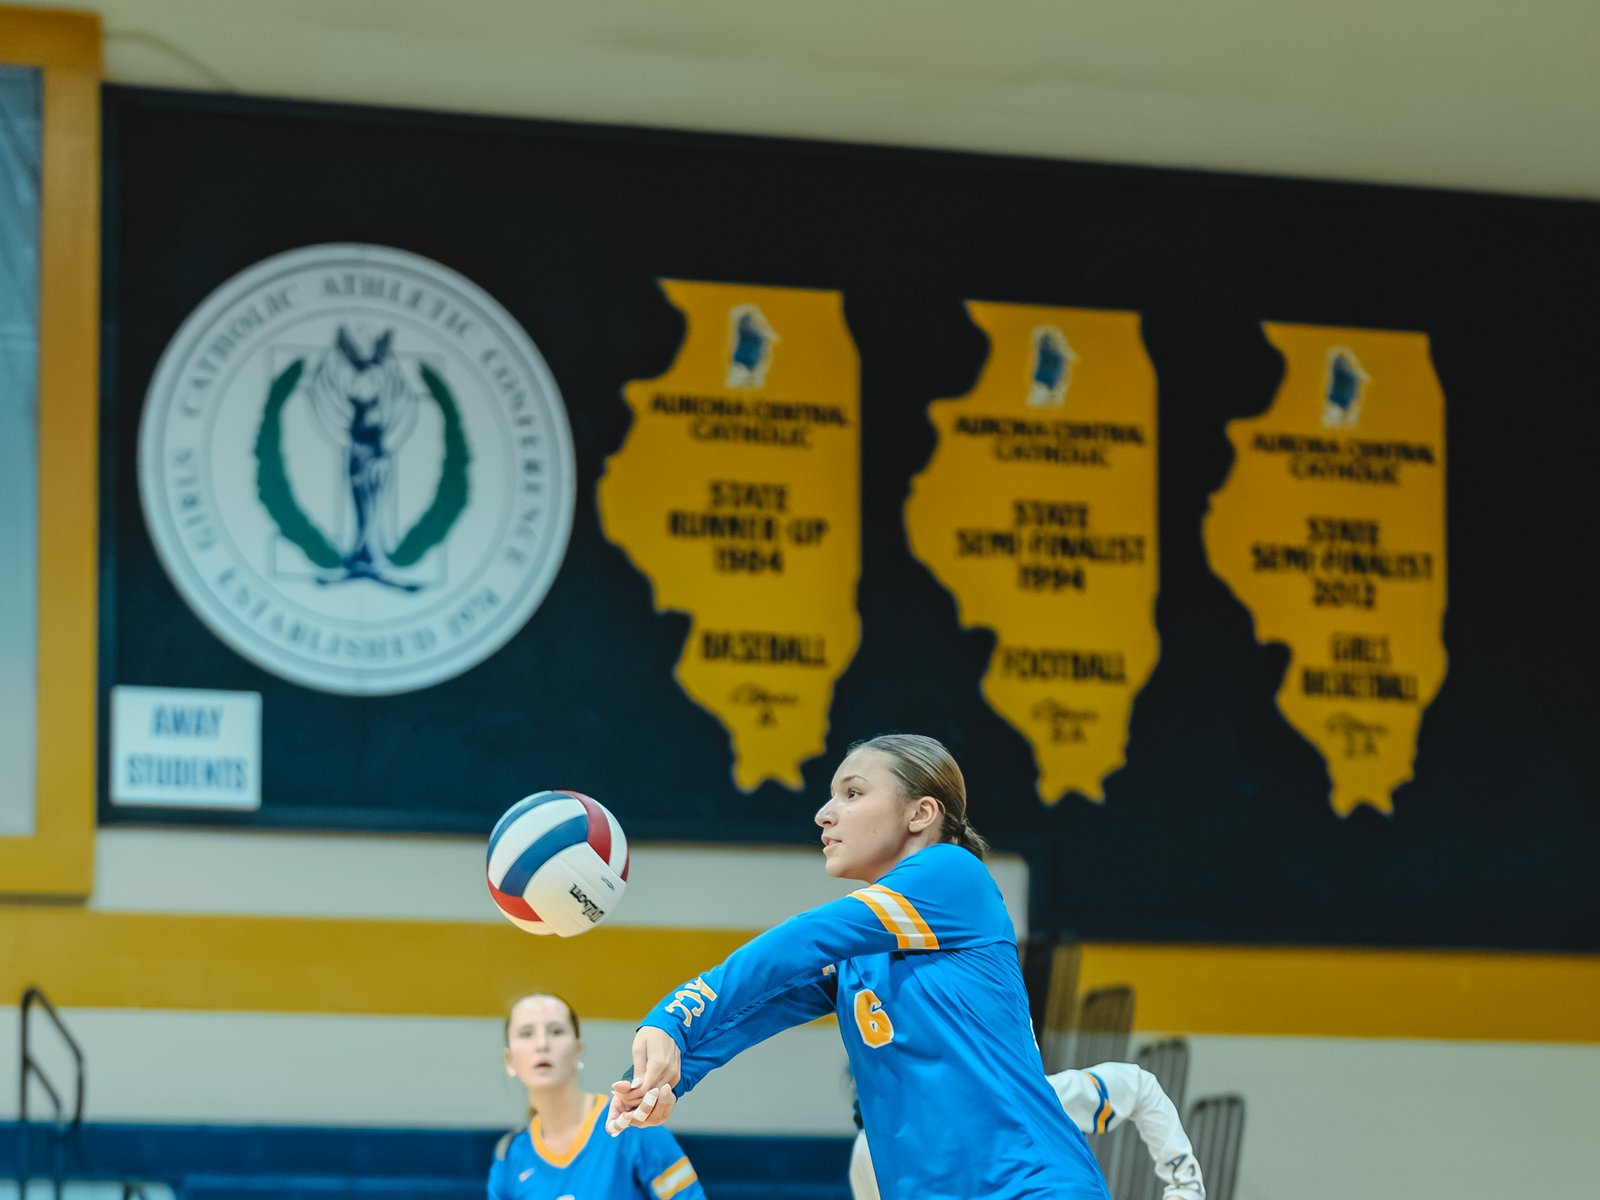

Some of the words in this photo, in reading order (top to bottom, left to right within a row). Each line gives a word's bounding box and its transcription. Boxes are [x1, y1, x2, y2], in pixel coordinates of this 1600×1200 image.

[321, 271, 473, 340] ATHLETIC
[182, 286, 299, 418] CATHOLIC
[689, 416, 813, 450] CATHOLIC
[480, 348, 545, 566] CONFERENCE
[174, 446, 217, 554] GIRLS
[708, 479, 788, 513] STATE
[1013, 499, 1089, 529] STATE
[1307, 517, 1380, 547] STATE
[1018, 563, 1087, 595] 1994
[216, 567, 440, 662] ESTABLISHED
[700, 630, 828, 667] BASEBALL
[1001, 646, 1128, 685] FOOTBALL
[1302, 667, 1419, 702] BASKETBALL
[152, 704, 223, 738] AWAY
[126, 752, 248, 792] STUDENTS
[854, 988, 895, 1050] 6
